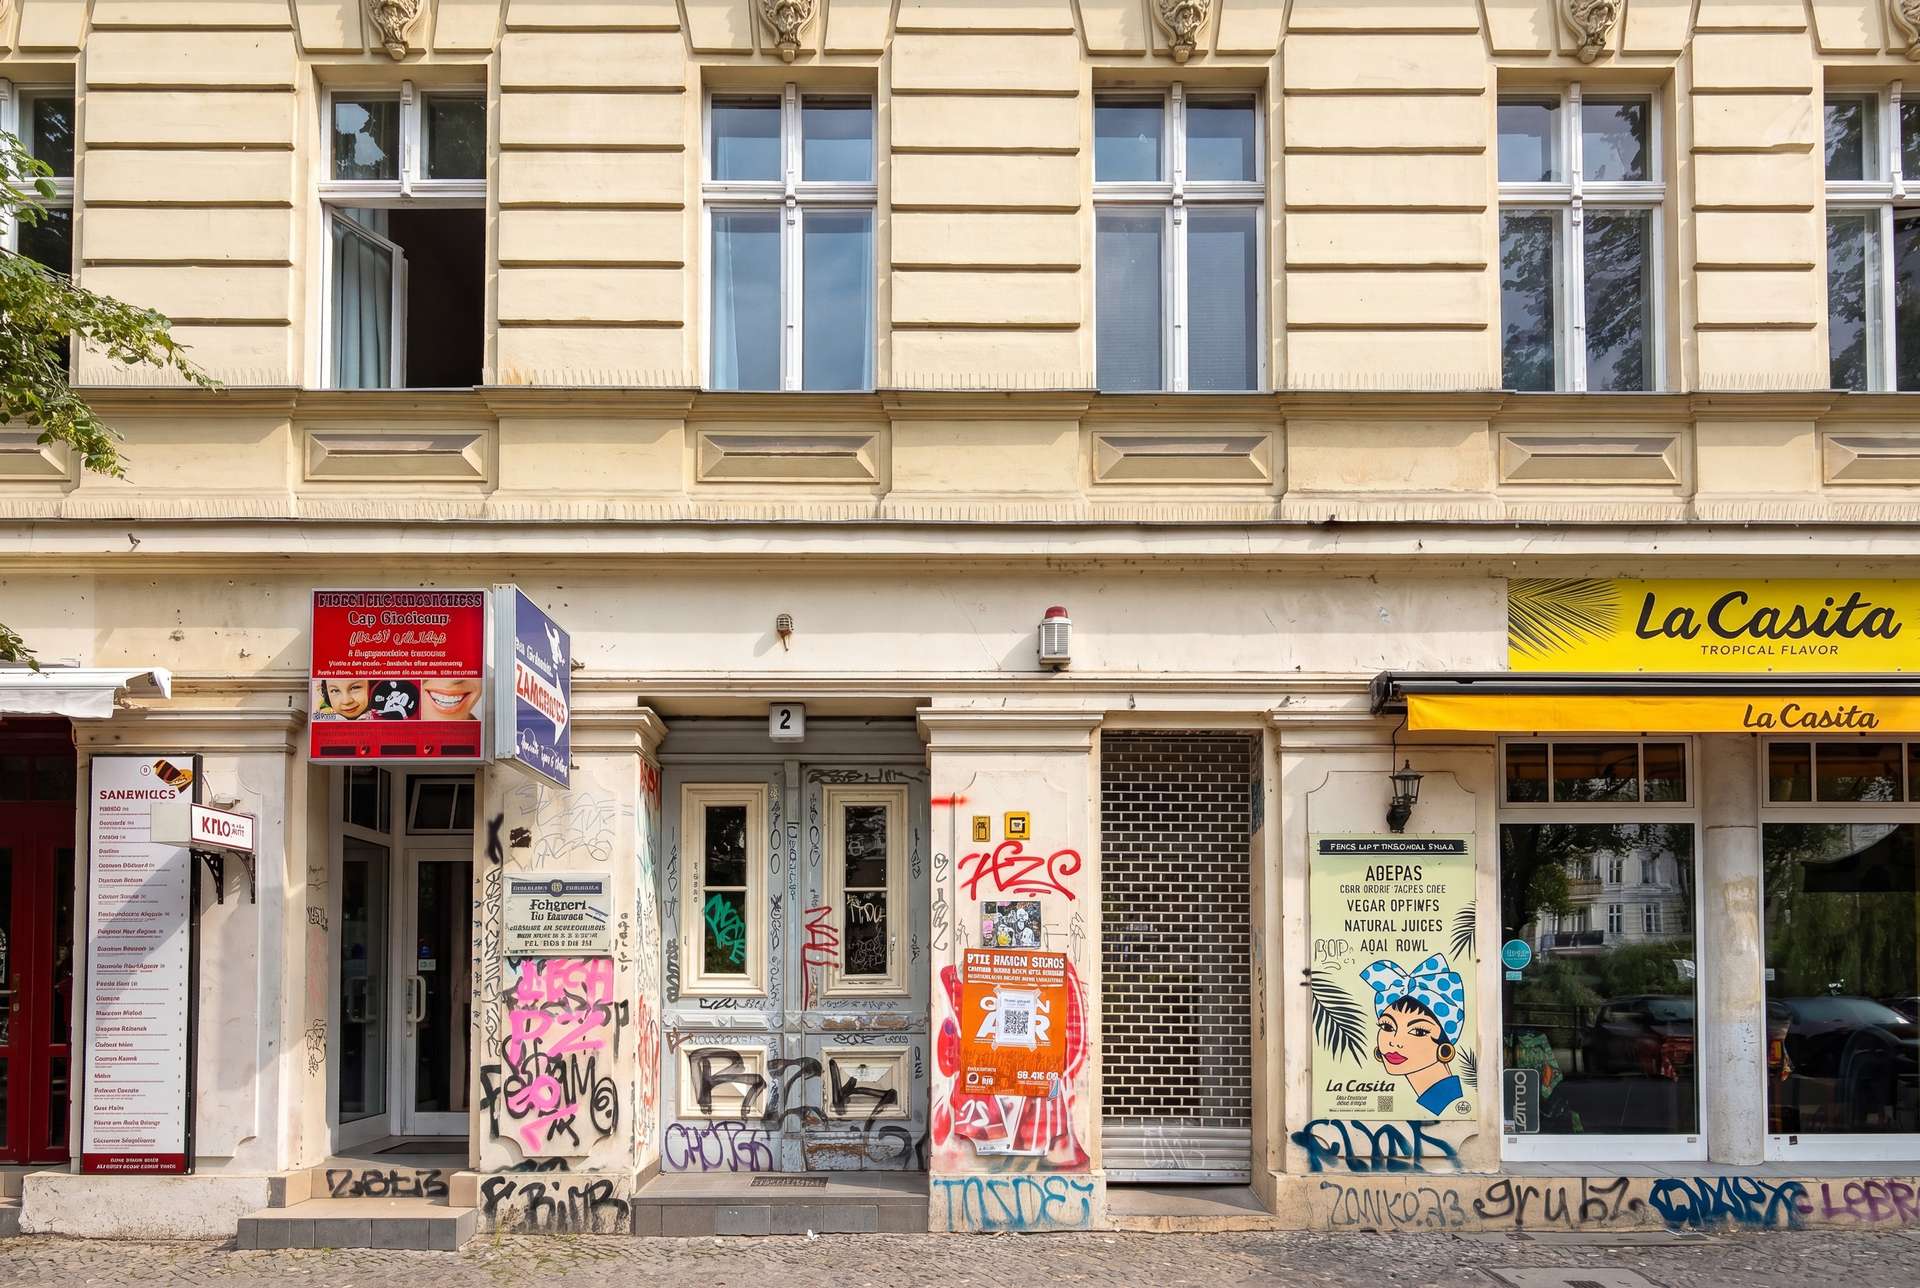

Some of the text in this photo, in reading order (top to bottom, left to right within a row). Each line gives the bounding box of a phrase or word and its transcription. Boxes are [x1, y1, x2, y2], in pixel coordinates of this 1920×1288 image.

[1635, 591, 1902, 640] La Casita
[1701, 645, 1838, 655] TROPICAL FLAVOR
[779, 709, 791, 730] 2
[1743, 703, 1880, 729] La Casita
[1344, 919, 1443, 932] NATURAL JUICES
[1326, 1079, 1395, 1092] La Casita
